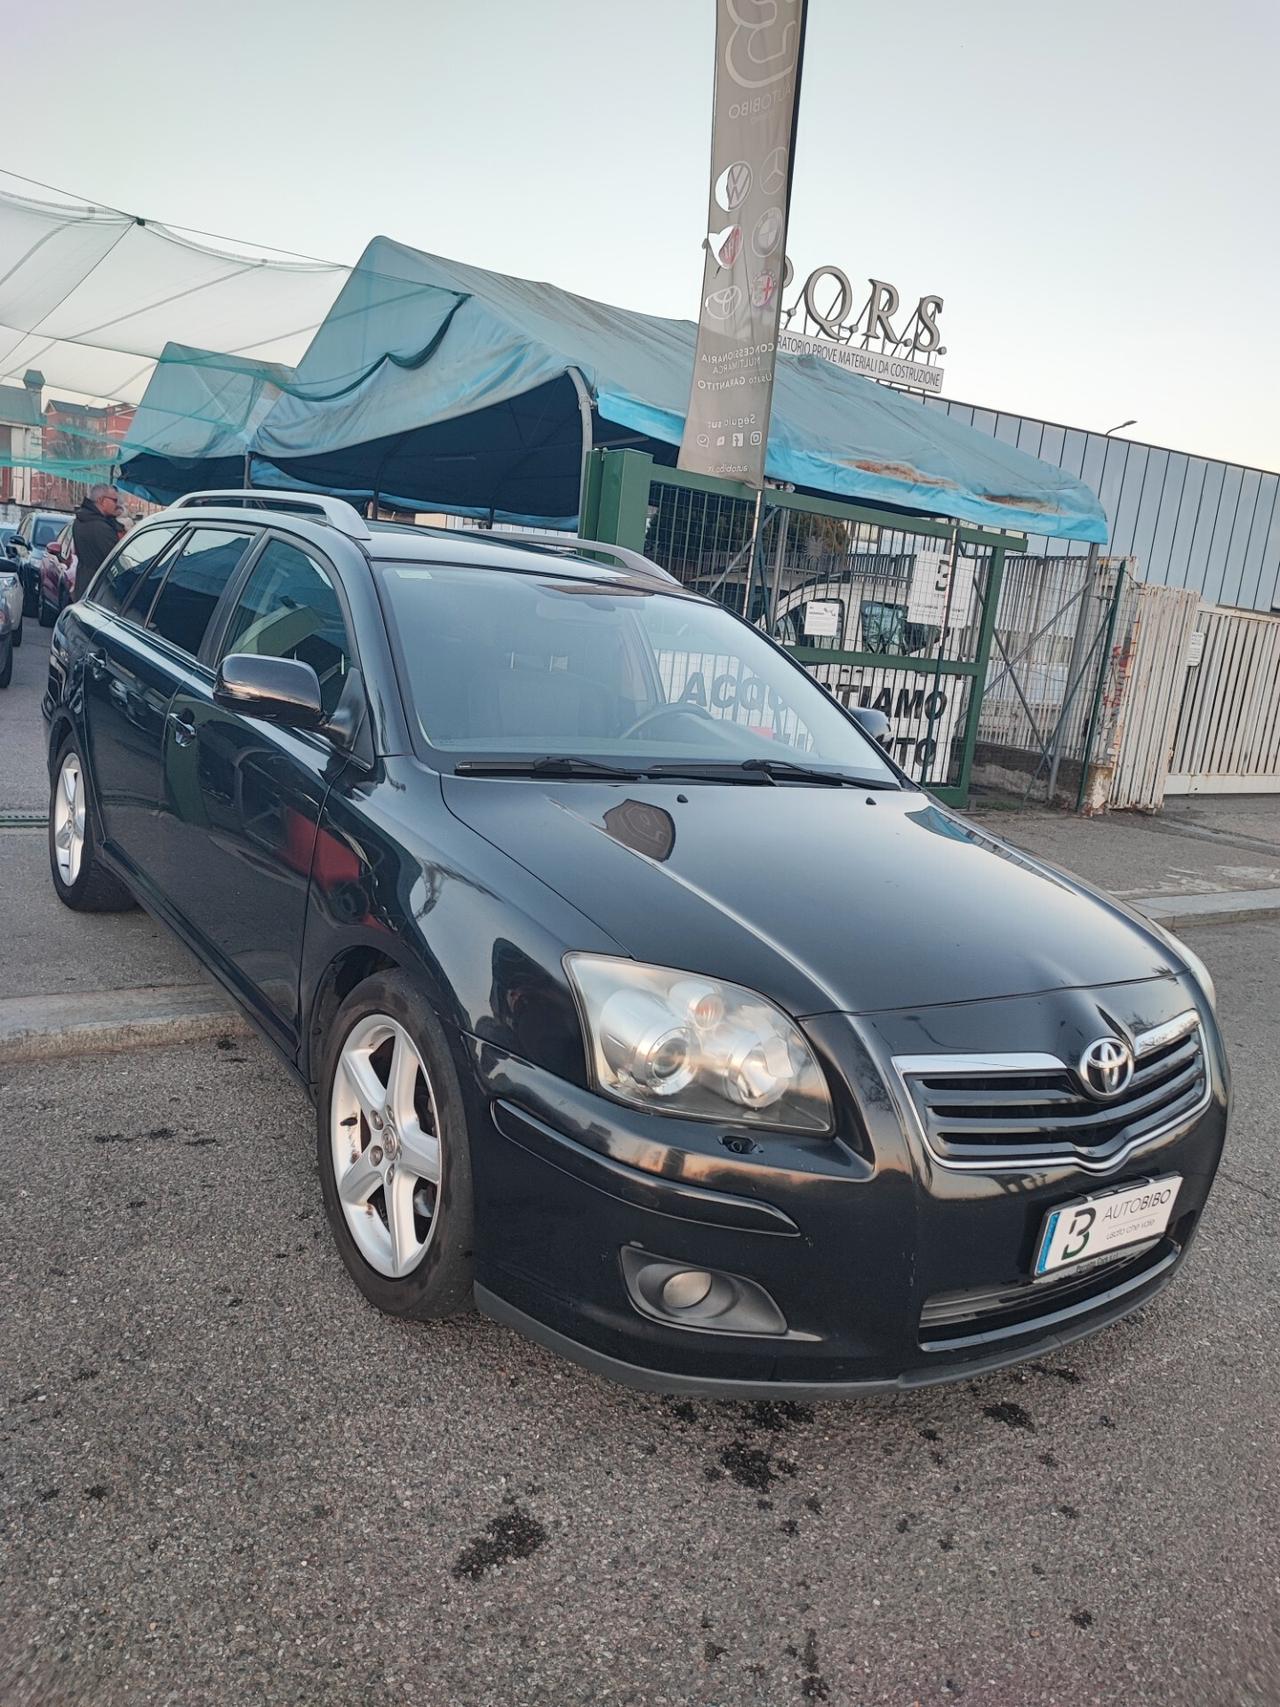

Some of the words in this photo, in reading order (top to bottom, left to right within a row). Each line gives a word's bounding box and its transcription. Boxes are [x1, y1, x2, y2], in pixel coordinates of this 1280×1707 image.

[812, 343, 838, 363] PROVE
[838, 350, 877, 372] MATERIALI
[879, 360, 890, 375] DA
[890, 363, 940, 387] COSTRUZIONE
[1102, 1189, 1172, 1222] AUTOBIBO
